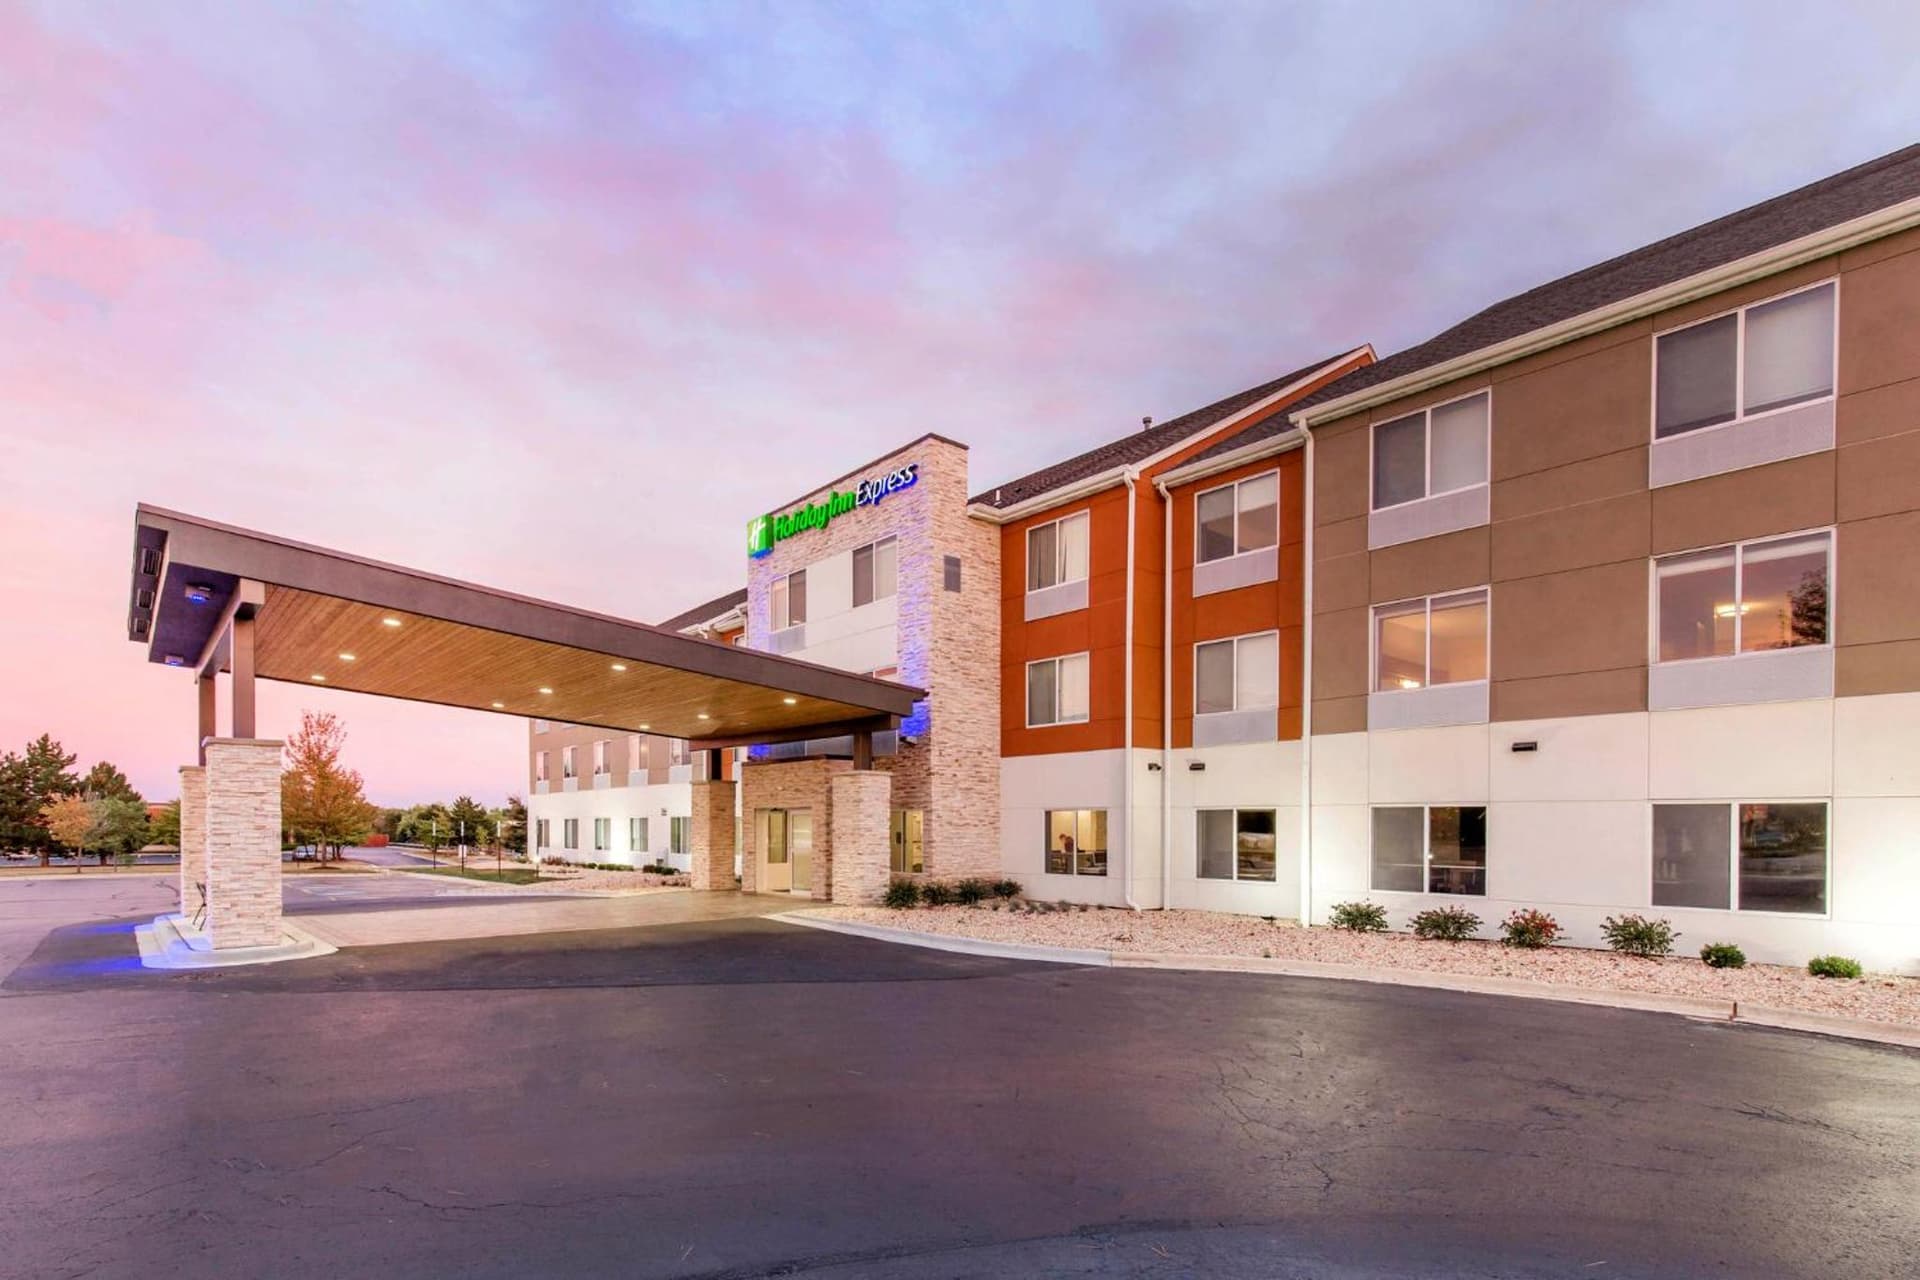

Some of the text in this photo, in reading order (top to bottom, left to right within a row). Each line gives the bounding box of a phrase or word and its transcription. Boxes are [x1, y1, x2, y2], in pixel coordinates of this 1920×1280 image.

[774, 502, 829, 540] Holiday
[829, 491, 856, 518] Inn
[855, 463, 916, 505] Express
